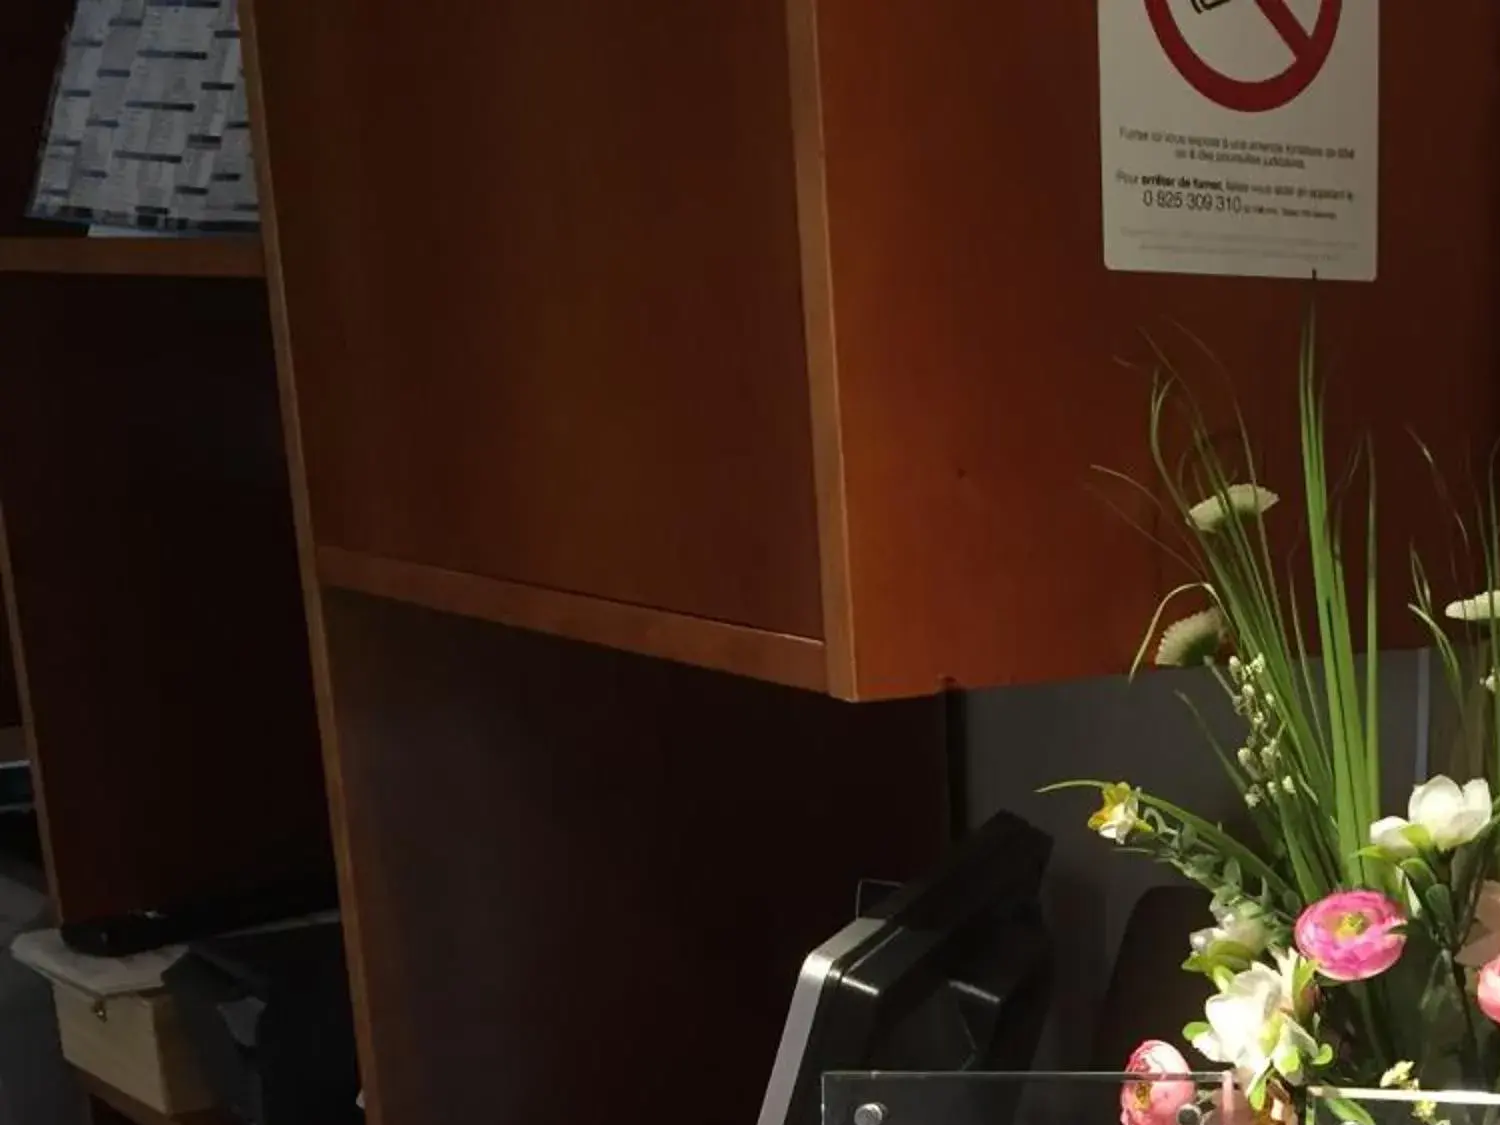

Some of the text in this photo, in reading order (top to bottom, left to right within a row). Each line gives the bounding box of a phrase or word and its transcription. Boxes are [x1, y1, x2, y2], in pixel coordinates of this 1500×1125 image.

[1143, 191, 1153, 208] 0
[1156, 191, 1184, 210] 825
[1187, 193, 1213, 212] 309
[1216, 194, 1242, 214] 310
